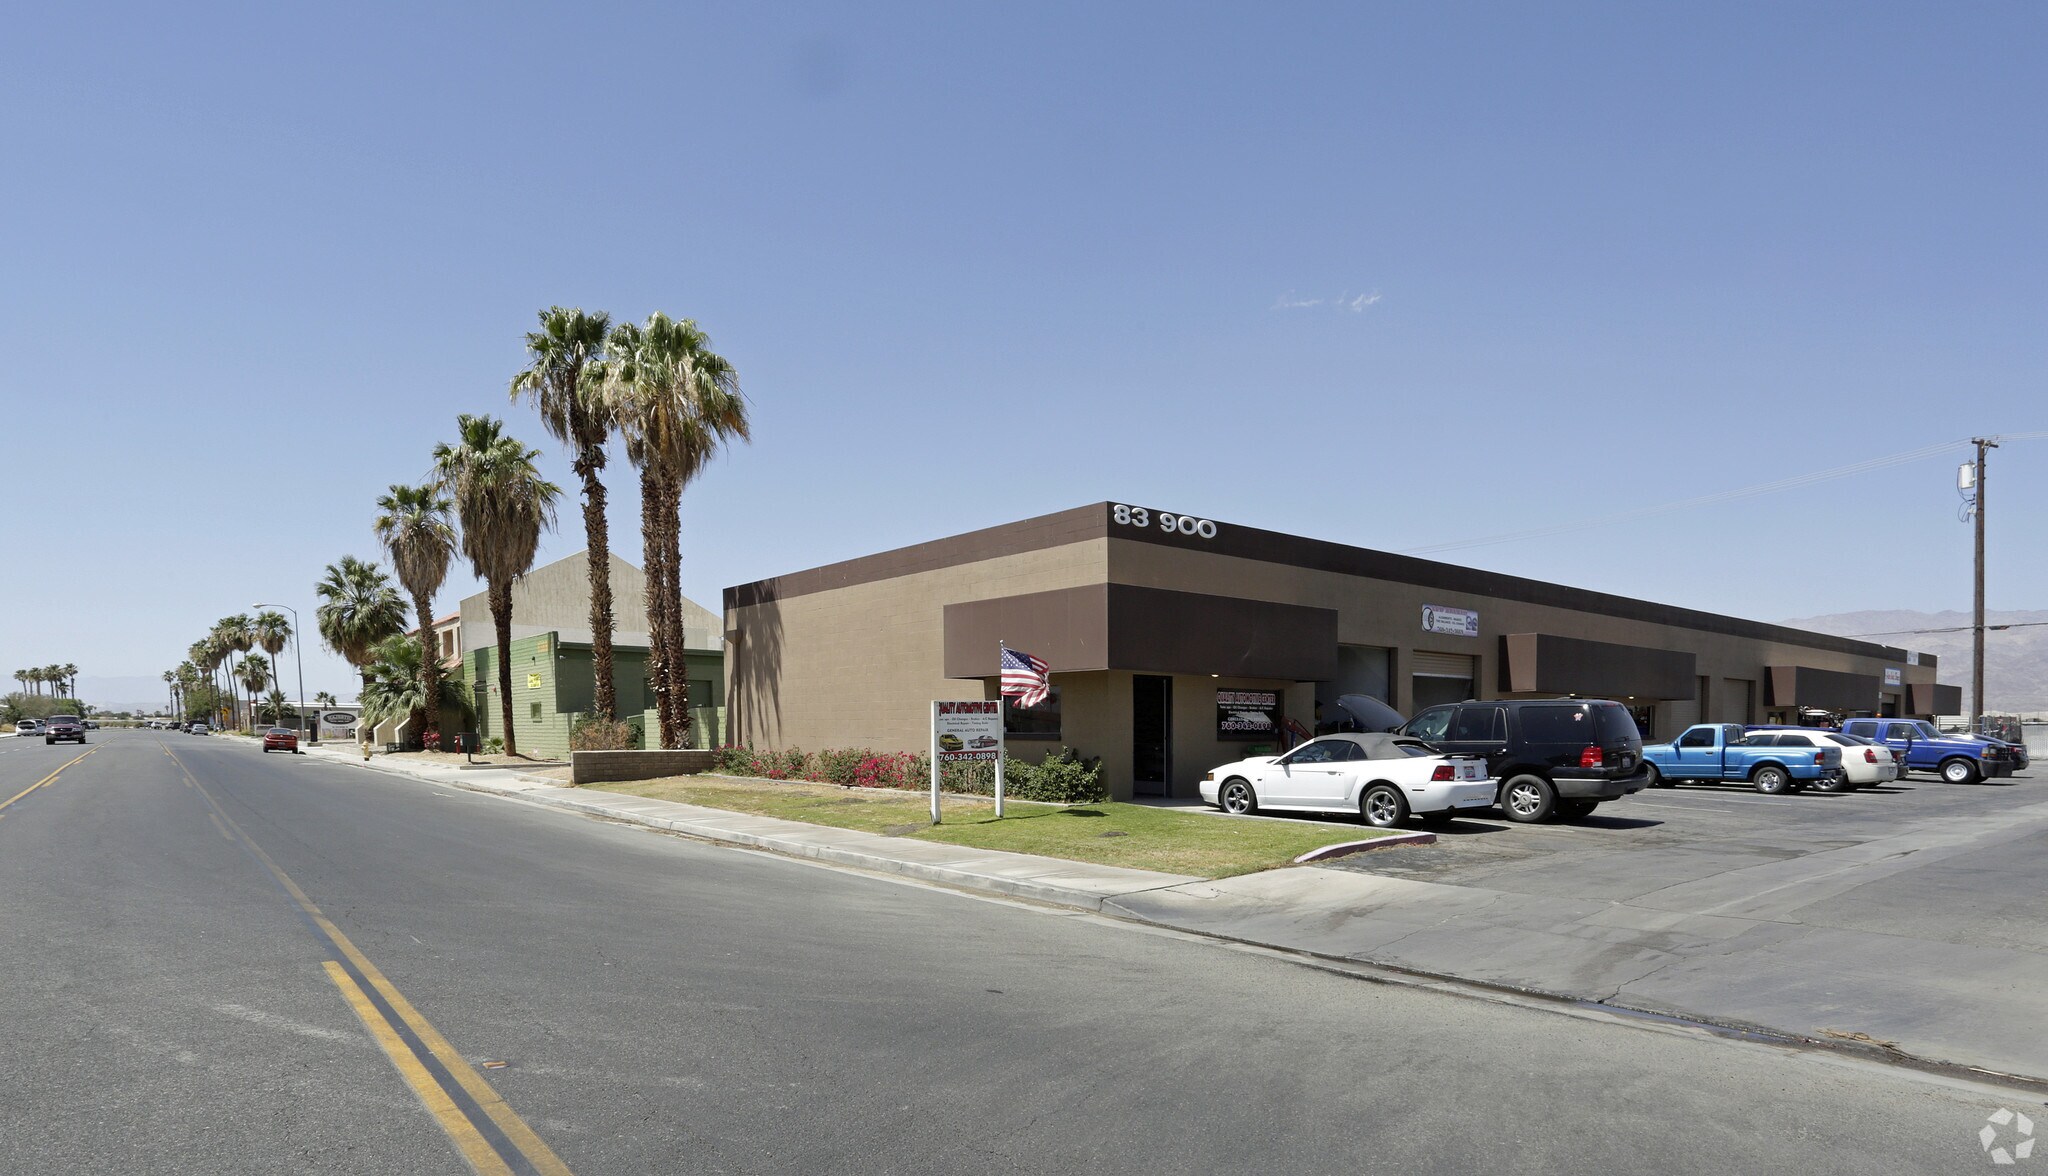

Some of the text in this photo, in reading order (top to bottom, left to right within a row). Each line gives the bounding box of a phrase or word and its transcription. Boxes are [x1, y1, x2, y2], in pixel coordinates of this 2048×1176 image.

[1113, 504, 1217, 539] 83 900
[956, 702, 982, 714] AUTOMOTIVE
[940, 753, 996, 761] 760-342-0898
